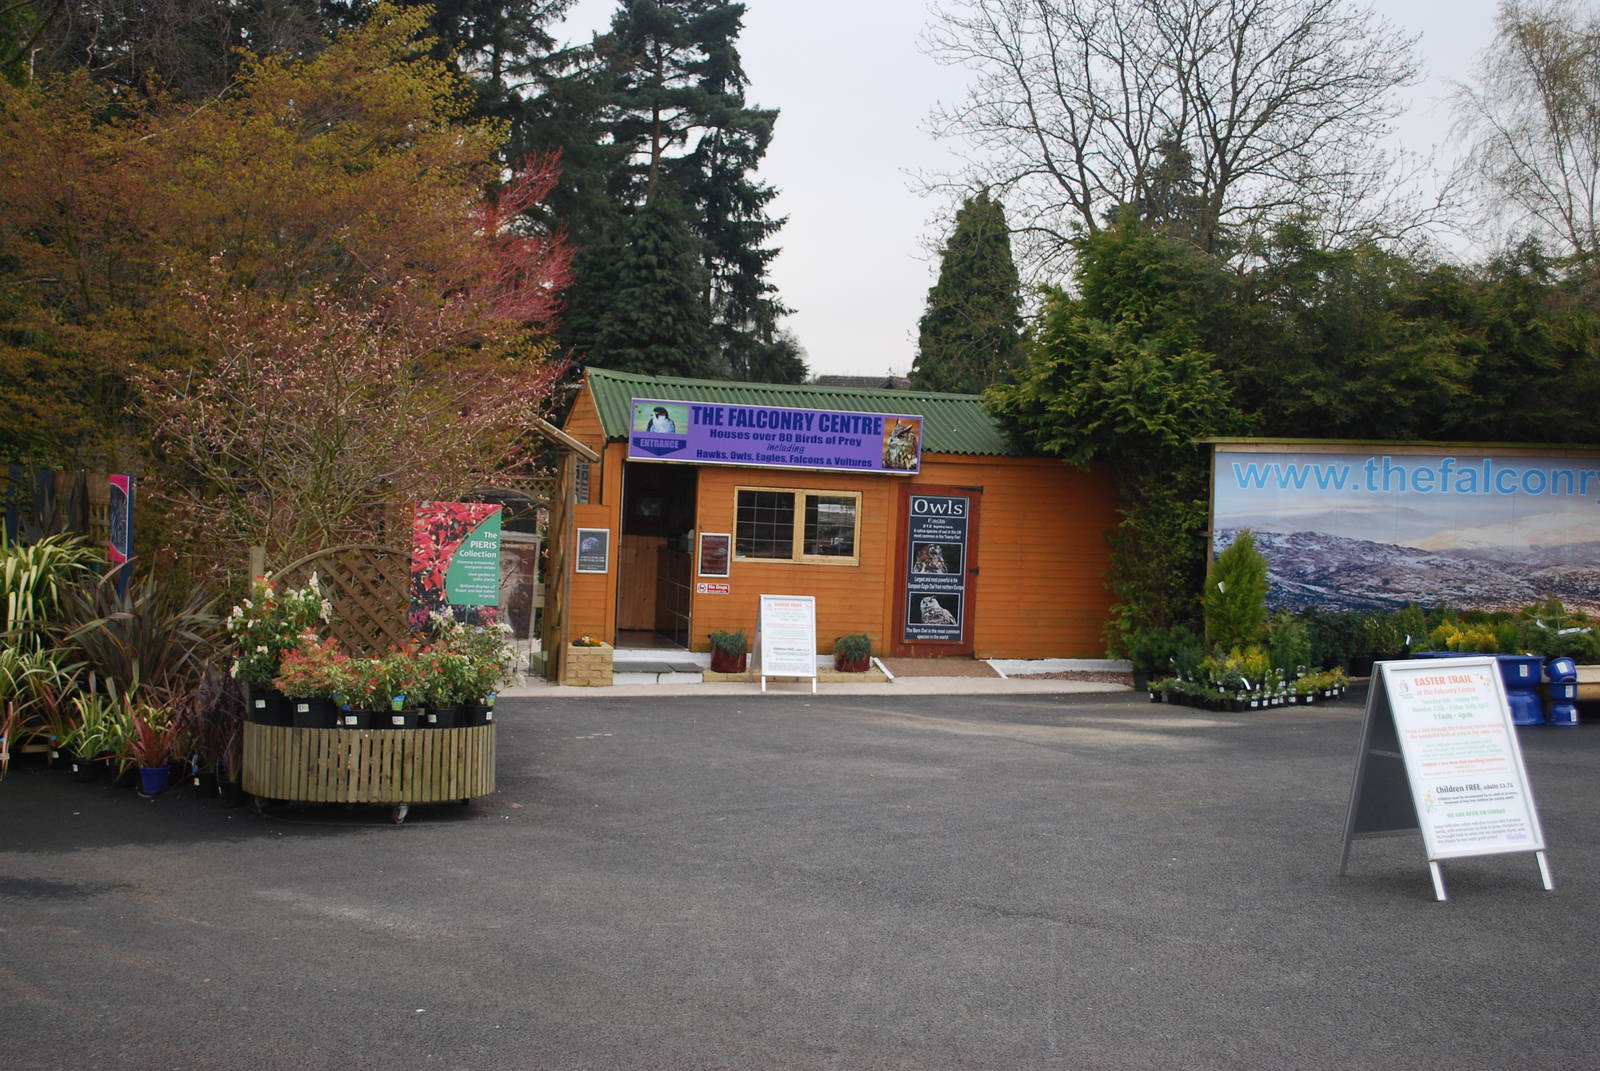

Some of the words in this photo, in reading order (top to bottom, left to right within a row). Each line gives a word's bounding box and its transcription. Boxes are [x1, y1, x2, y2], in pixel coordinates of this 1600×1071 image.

[692, 406, 724, 426] THE
[728, 408, 814, 431] FALCONRY
[818, 413, 882, 436] CENTRE
[639, 439, 679, 449] ENTRANCE
[710, 429, 750, 440] Houses
[752, 432, 776, 441] over
[779, 433, 793, 442] 80
[795, 434, 824, 445] Birds
[826, 436, 836, 445] of
[839, 437, 862, 447] Prey
[767, 442, 805, 454] including
[790, 455, 824, 465] Falcons
[835, 457, 872, 467] Vultures
[1232, 456, 1600, 504] www.thefalconr
[914, 498, 963, 515] Owls
[484, 531, 497, 539] The
[470, 540, 497, 549] PIERIS
[459, 549, 497, 558] Collection
[1414, 676, 1446, 687] EASTER
[1447, 674, 1472, 684] TRAIL
[1436, 784, 1464, 793] Children
